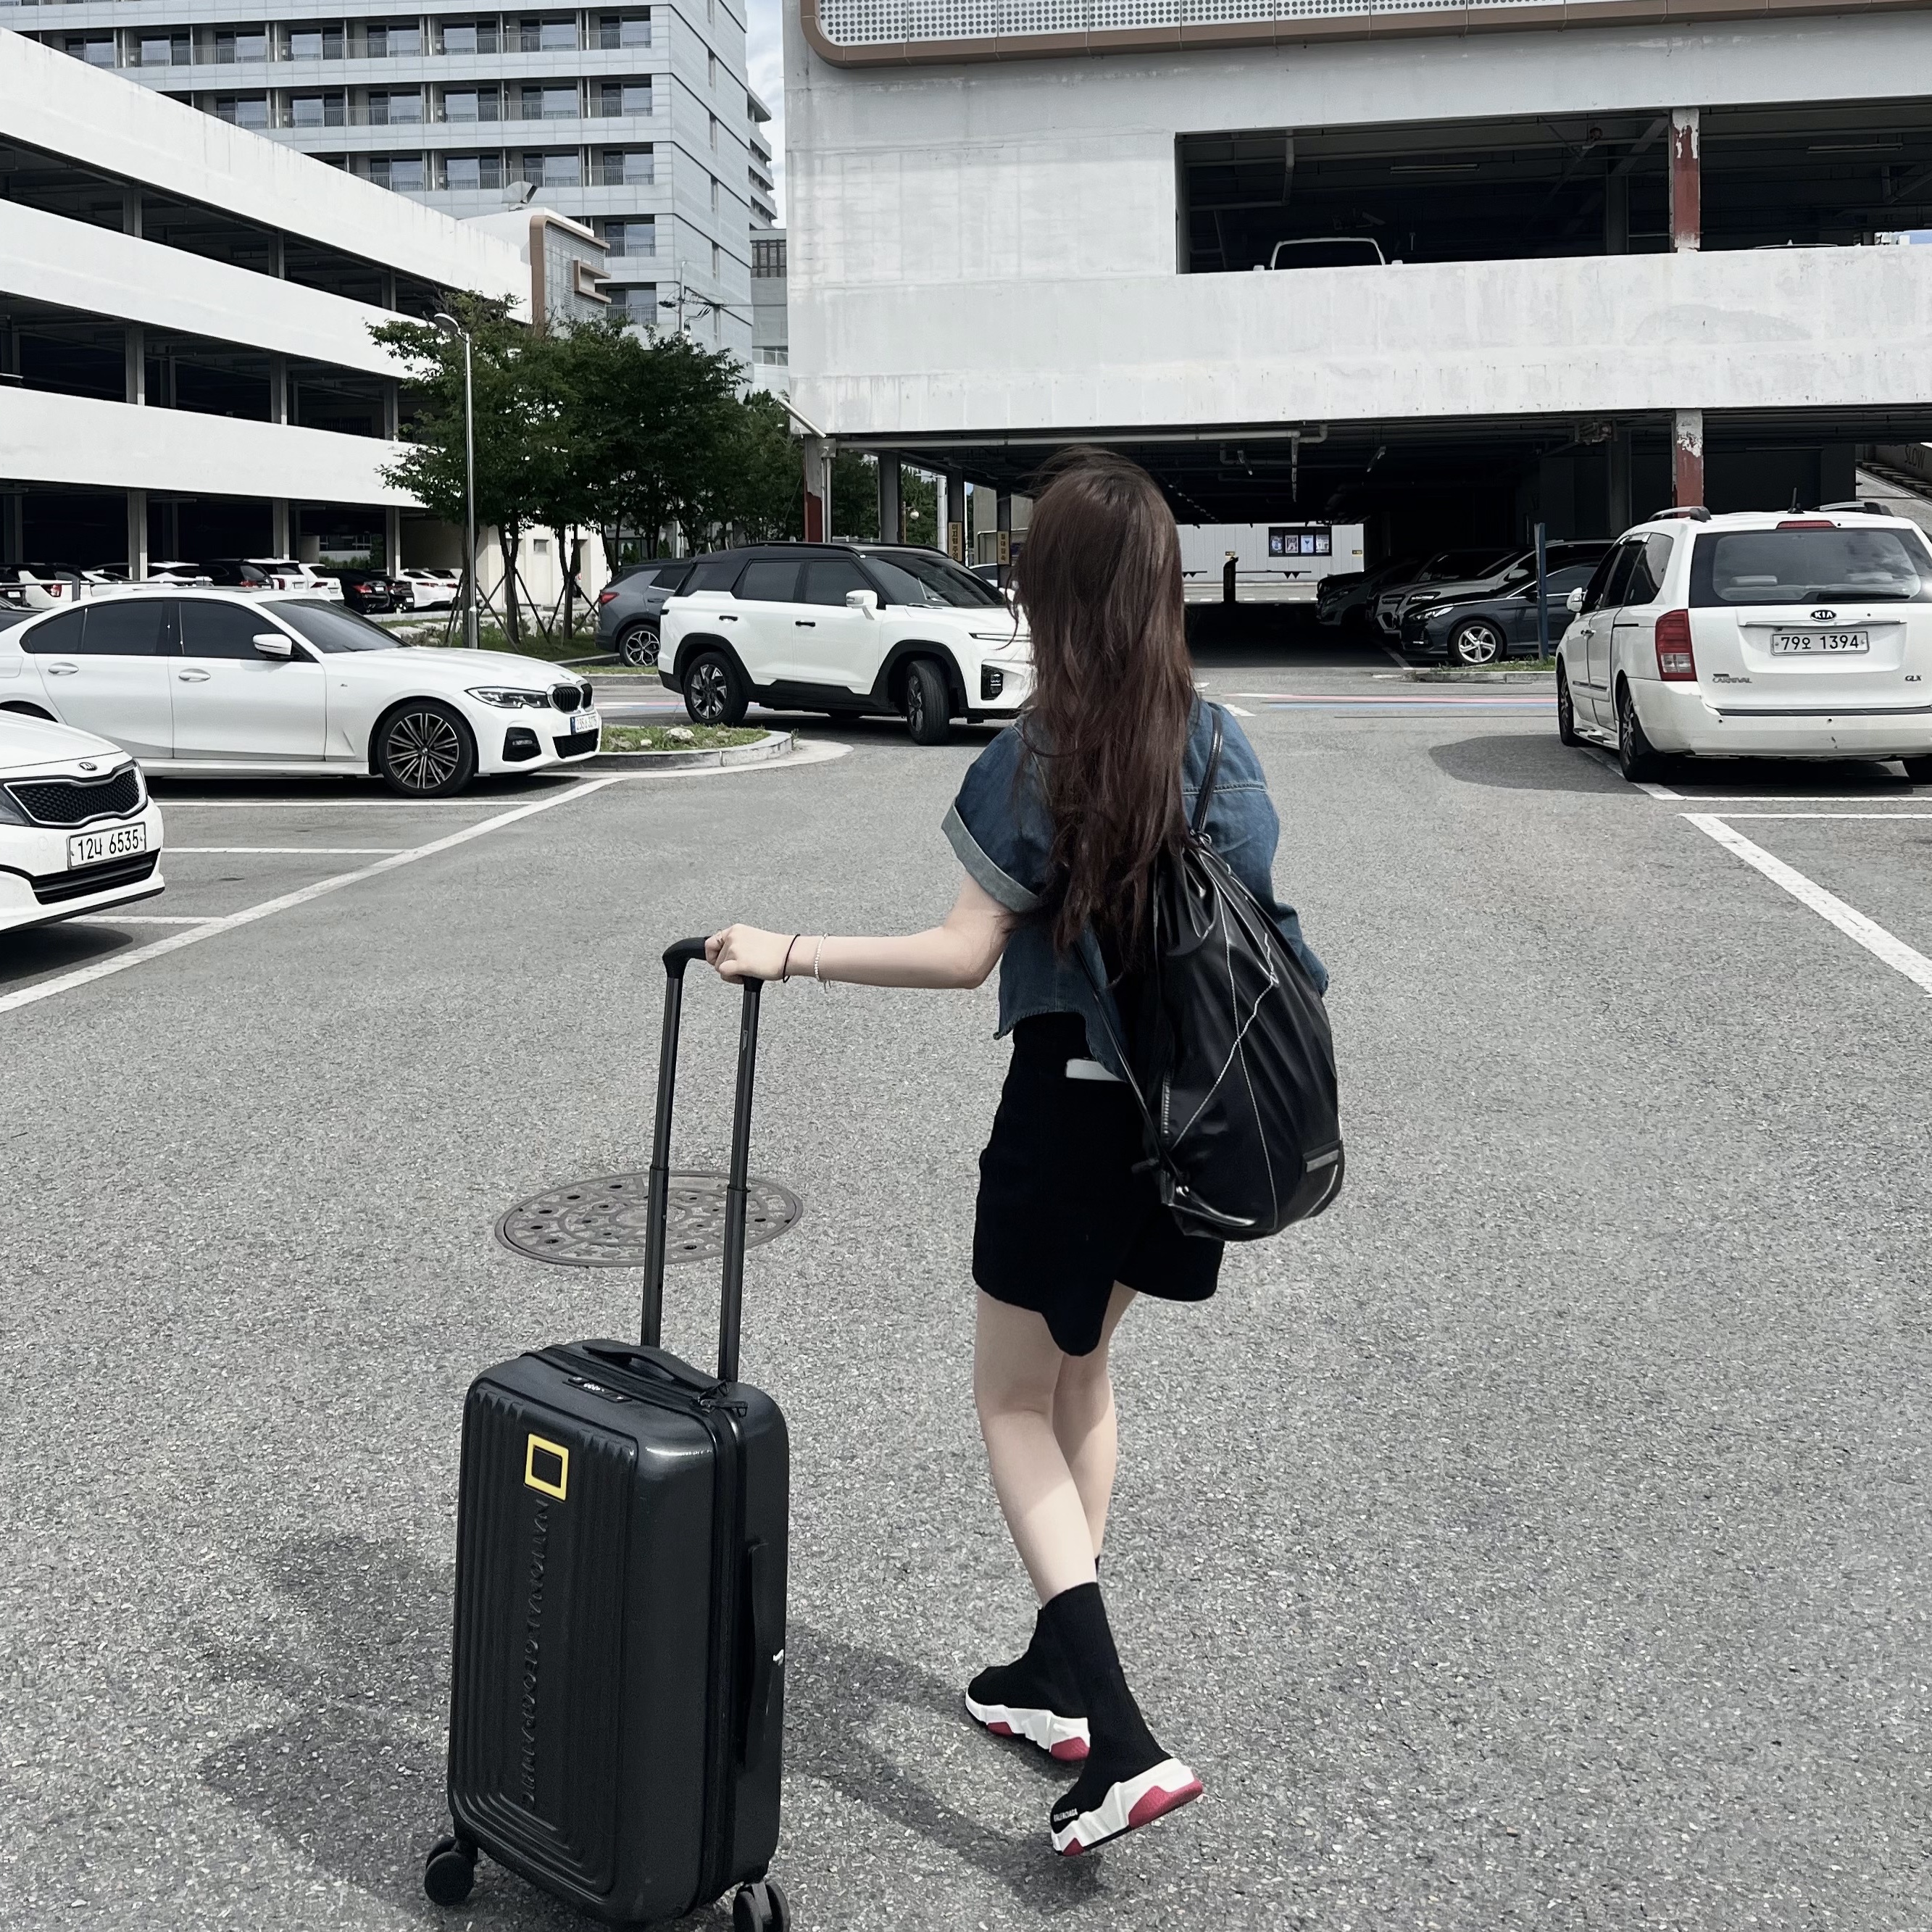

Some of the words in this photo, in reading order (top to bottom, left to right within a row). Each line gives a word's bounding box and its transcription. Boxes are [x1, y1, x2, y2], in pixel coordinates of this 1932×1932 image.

[1904, 444, 1925, 470] SLOW
[1781, 636, 1811, 650] 79오
[1820, 635, 1859, 649] 1394
[109, 829, 138, 854] 6535
